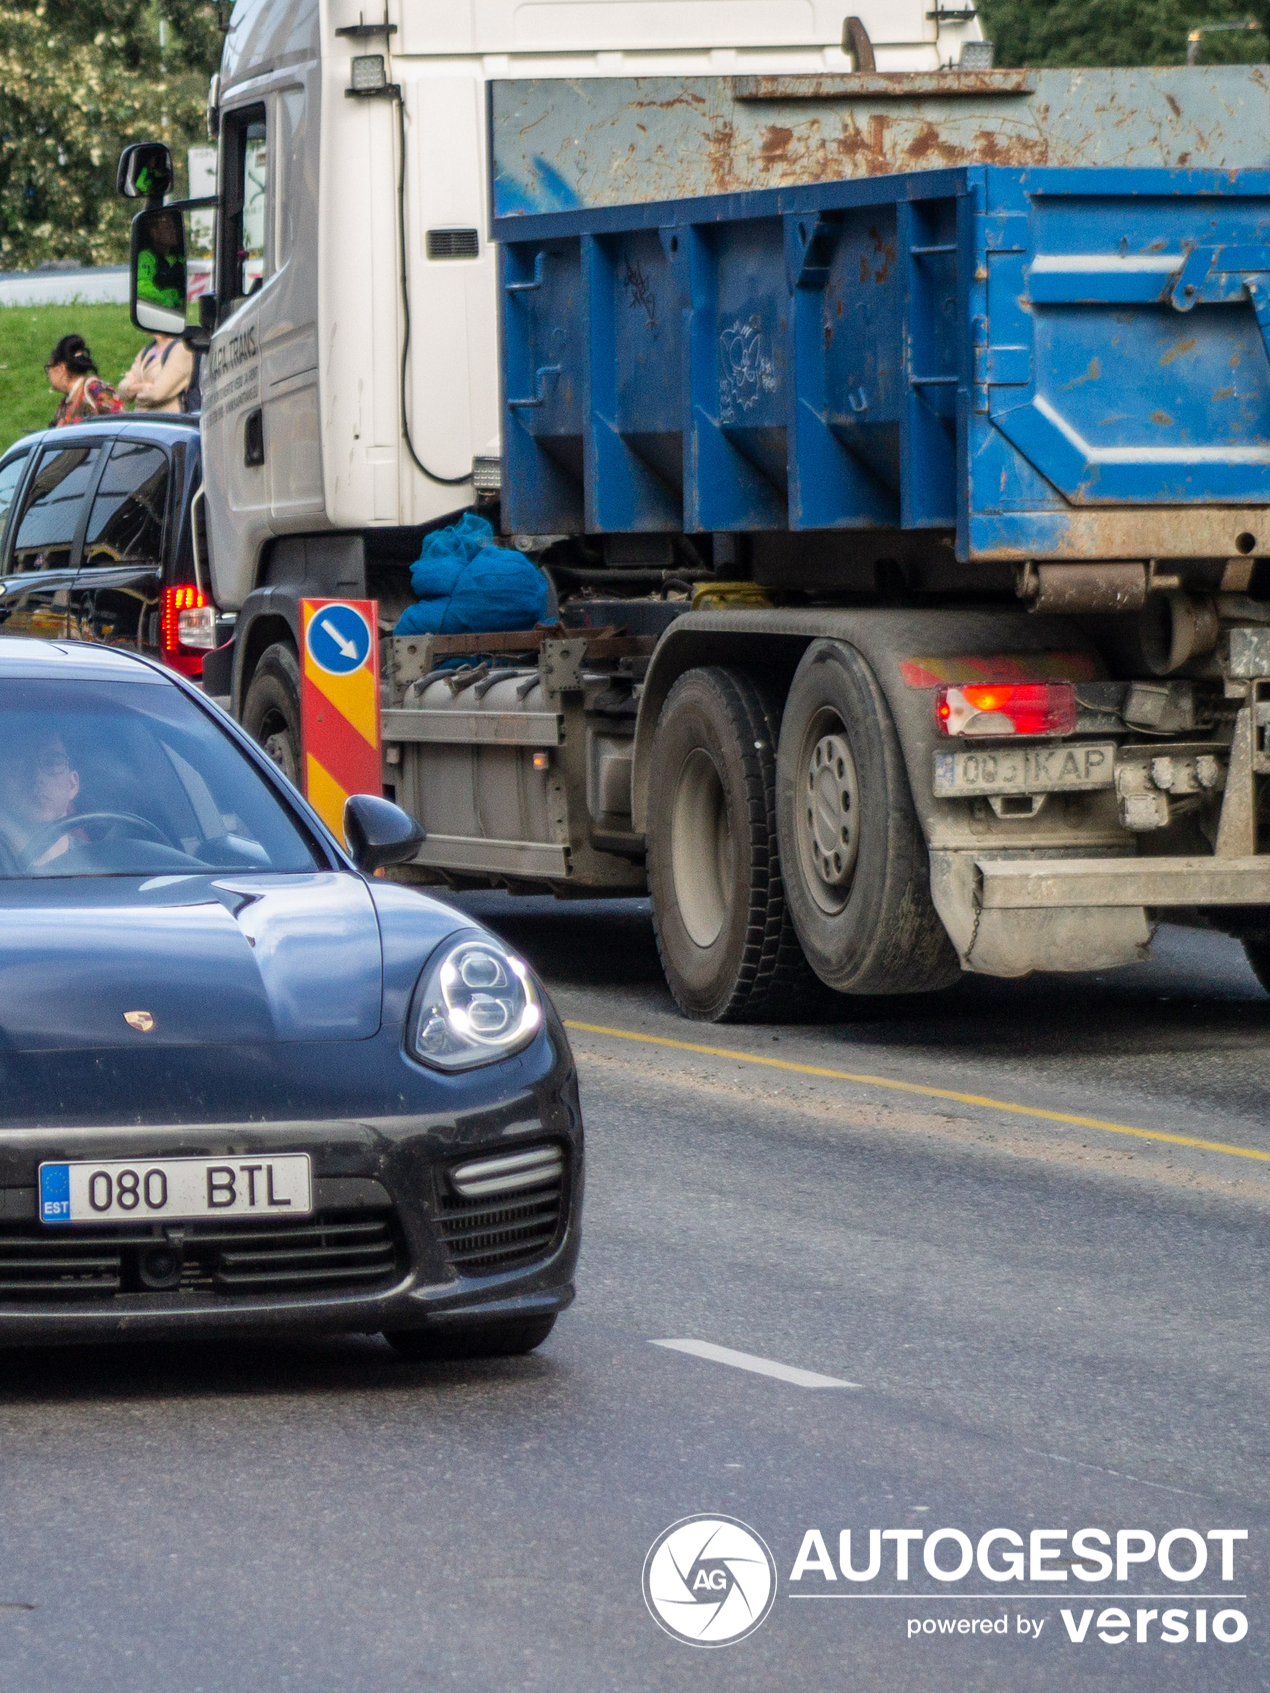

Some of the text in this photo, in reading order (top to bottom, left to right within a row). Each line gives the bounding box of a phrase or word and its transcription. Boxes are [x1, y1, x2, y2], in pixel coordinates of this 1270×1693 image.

[1033, 750, 1105, 782] KAP
[44, 1164, 291, 1214] EST 080 BTL
